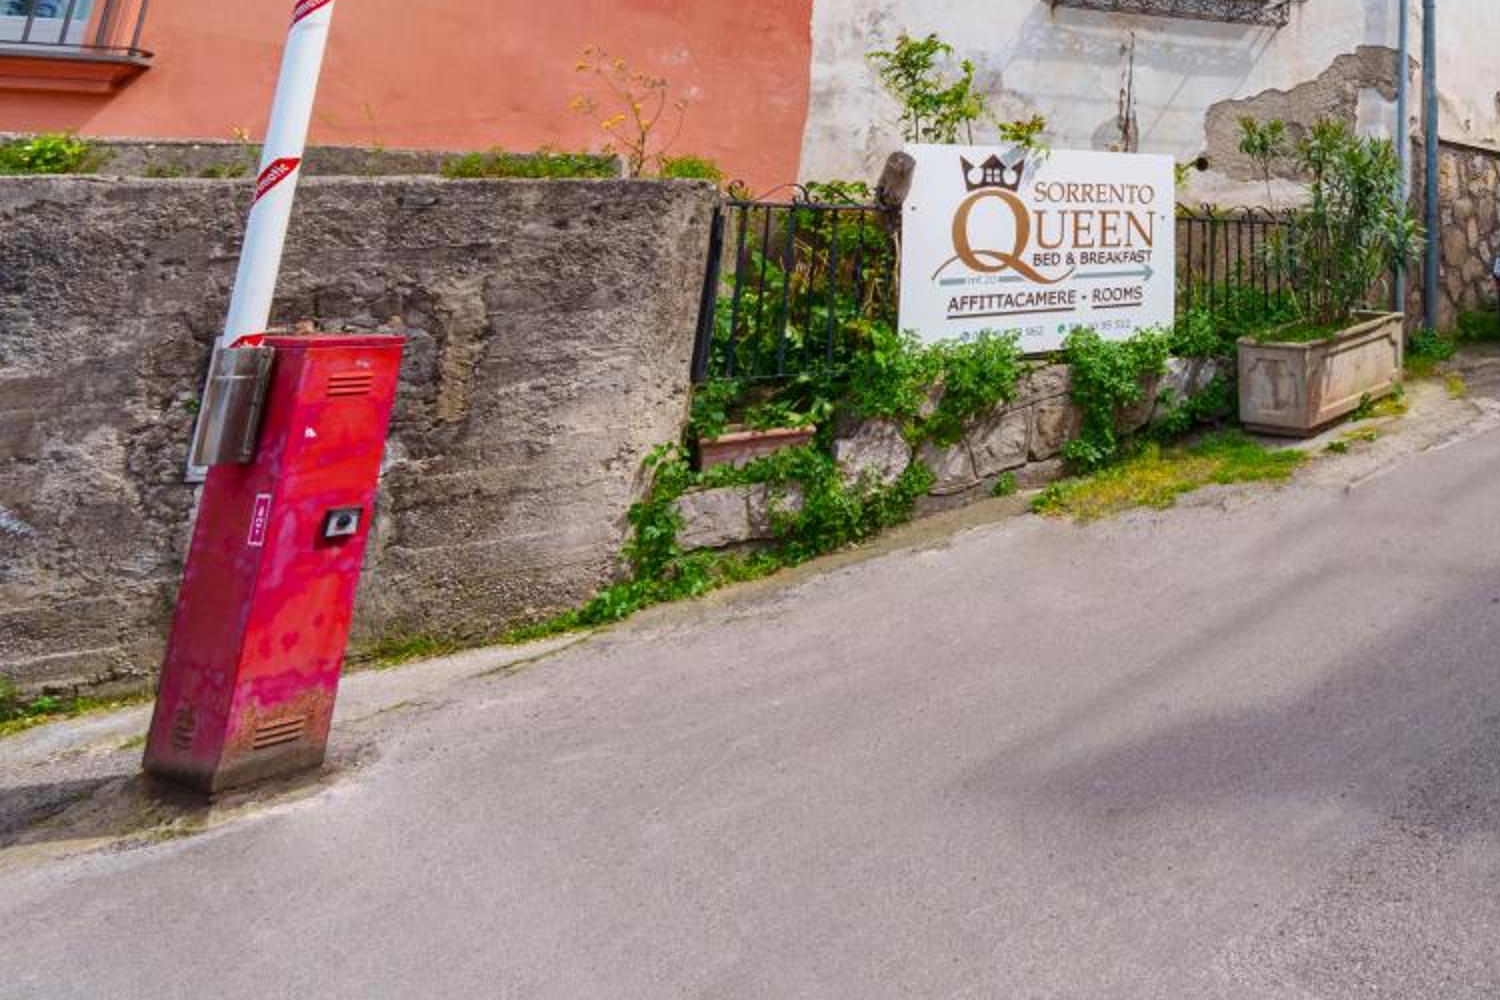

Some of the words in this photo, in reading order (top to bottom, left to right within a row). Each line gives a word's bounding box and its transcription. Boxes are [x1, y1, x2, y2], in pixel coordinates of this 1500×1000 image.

[1033, 181, 1155, 204] SORRENTO
[932, 187, 1157, 284] QUEEN
[1033, 252, 1060, 267] BED
[1065, 251, 1076, 265] &
[1080, 250, 1153, 265] BREAKFAST
[947, 289, 1077, 312] AFFITTACAMERE
[1092, 286, 1143, 302] ROOMS
